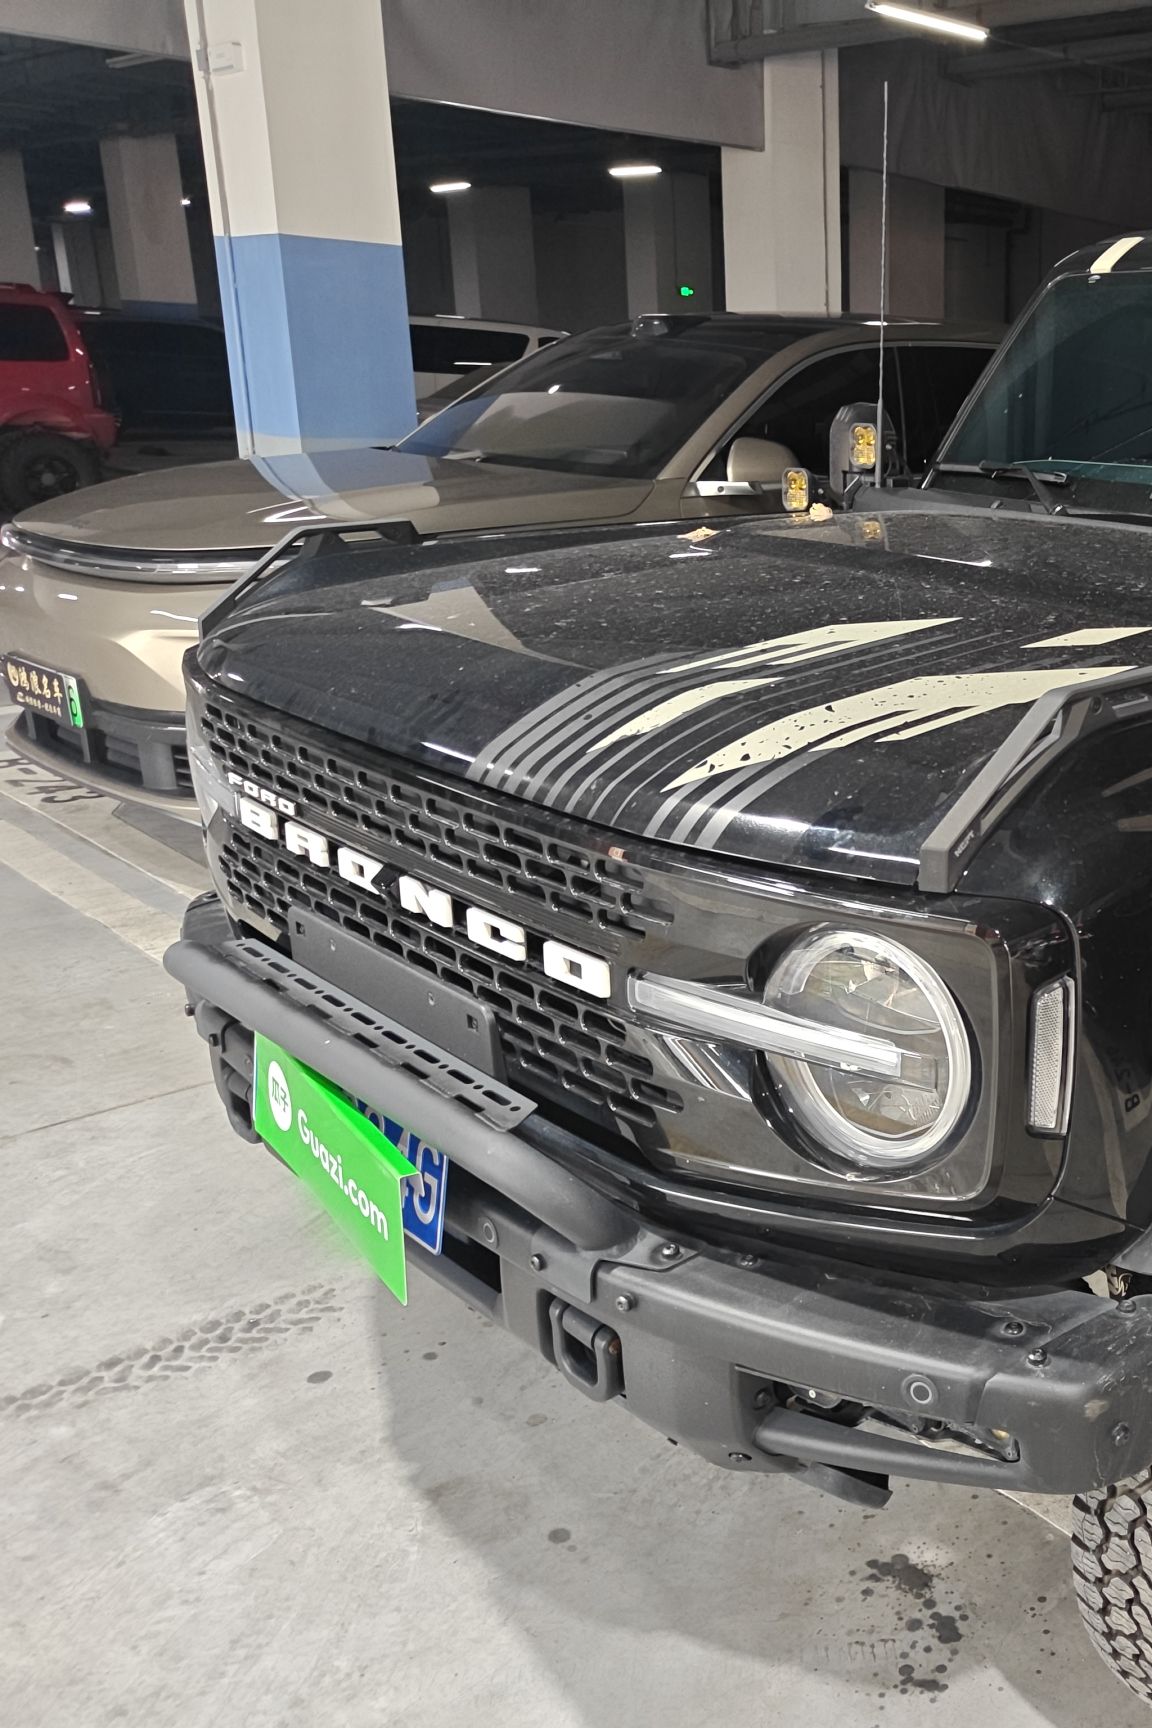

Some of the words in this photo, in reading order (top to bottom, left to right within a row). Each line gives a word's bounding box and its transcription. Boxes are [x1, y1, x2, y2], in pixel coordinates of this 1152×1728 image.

[227, 771, 297, 816] FORD
[239, 797, 612, 999] BRONCO
[271, 1076, 289, 1113] 瓜子
[297, 1108, 389, 1241] Guazi.com
